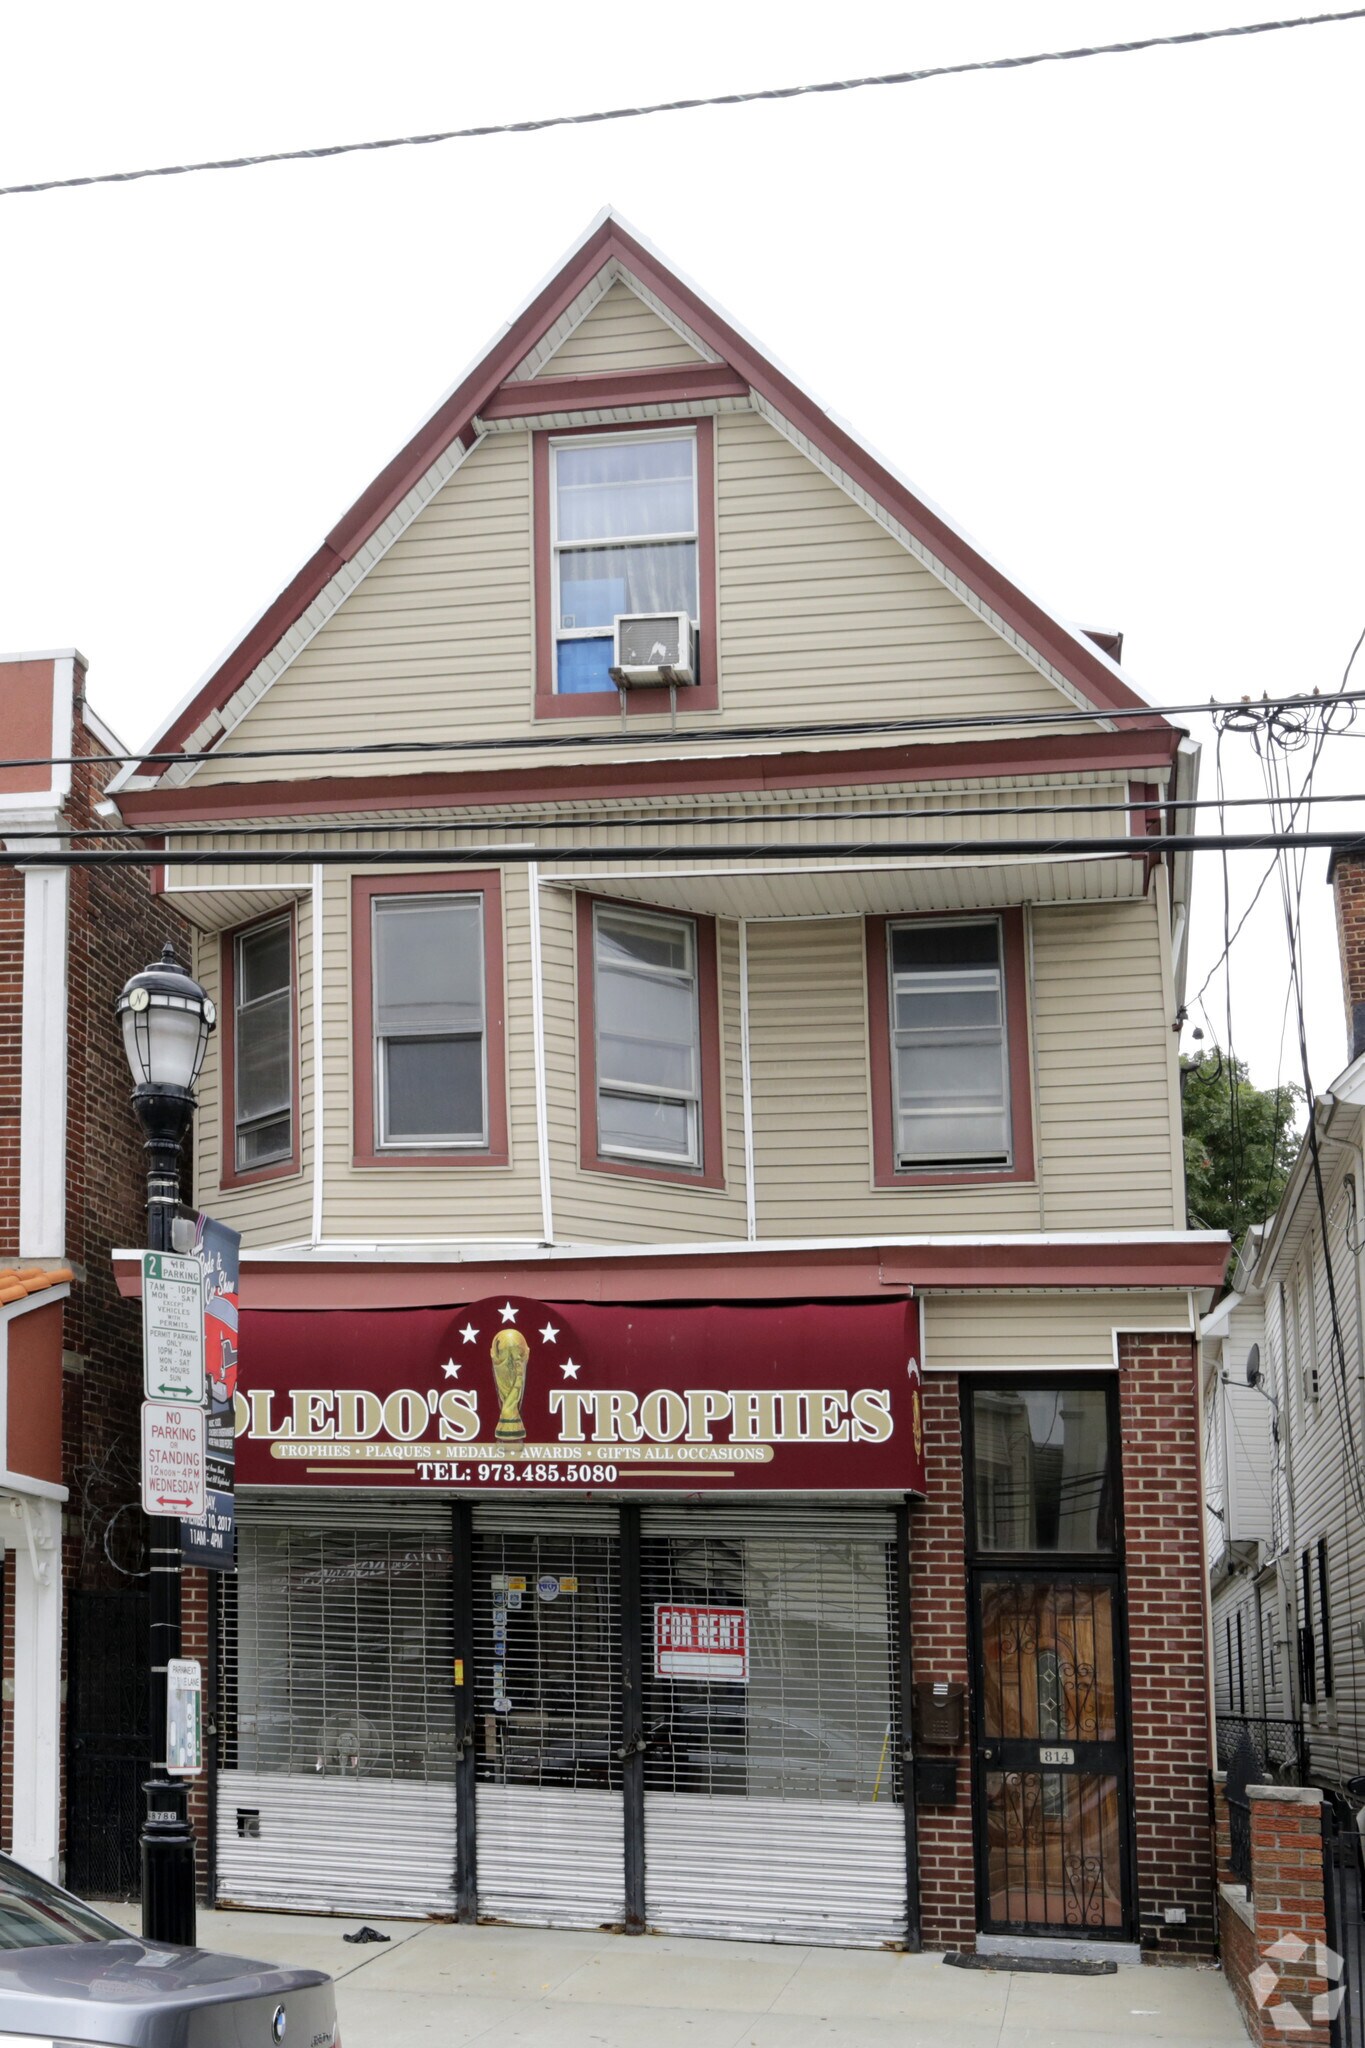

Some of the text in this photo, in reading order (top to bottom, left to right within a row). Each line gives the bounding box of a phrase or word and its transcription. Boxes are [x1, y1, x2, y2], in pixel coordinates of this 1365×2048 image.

[149, 1256, 156, 1275] 2
[164, 1269, 199, 1281] PARKING
[149, 1281, 165, 1291] 7AM
[178, 1285, 197, 1296] 10PM
[152, 1291, 168, 1300] MON
[182, 1294, 195, 1303] SAT
[158, 1306, 190, 1315] VEHICLES
[163, 1300, 184, 1308] EXCEPT
[159, 1319, 188, 1329] PERMITS
[150, 1330, 198, 1342] PERMIT PARKING
[158, 1346, 173, 1356] 10PM
[179, 1348, 192, 1358] 7AM
[159, 1357, 172, 1365] MON
[170, 1366, 190, 1375] HOURS
[169, 1374, 182, 1382] SUN
[166, 1411, 181, 1425] NO
[549, 1388, 894, 1443] TROPHIES
[151, 1425, 196, 1441] PARKING
[170, 1441, 178, 1449] OR
[149, 1449, 199, 1466] STANDING
[279, 1445, 765, 1460] TROPHIES PLAQUES MEDALS AWARDS GIFTS ALL OCCASIONS
[417, 1462, 618, 1482] TEL: 973.485.5080
[149, 1478, 200, 1494] WEDNESDAY
[217, 1515, 232, 1532] 2017
[190, 1528, 207, 1546] 11AM
[210, 1532, 223, 1549] 4PM
[661, 1612, 741, 1649] FOR RENT
[1044, 1751, 1069, 1762] 814
